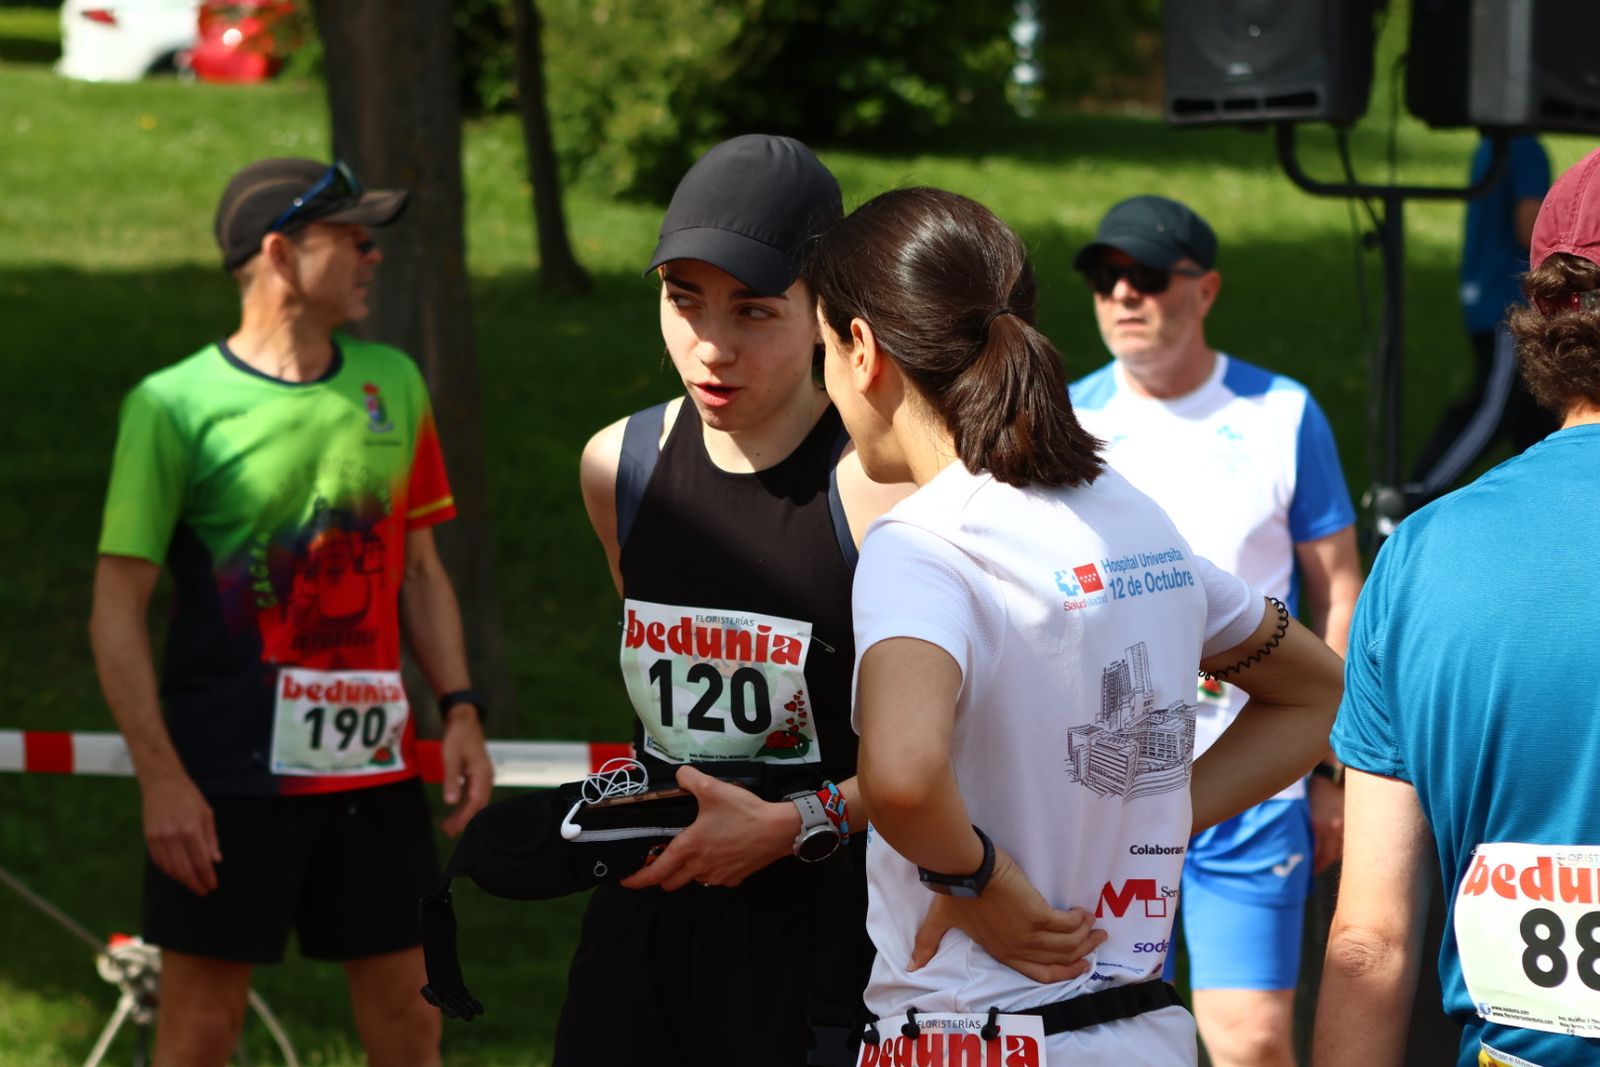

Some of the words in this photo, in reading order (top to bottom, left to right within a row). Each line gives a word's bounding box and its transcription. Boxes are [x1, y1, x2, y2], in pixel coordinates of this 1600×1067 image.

[1100, 555, 1138, 574] Hospital
[1109, 577, 1126, 600] 12
[1128, 576, 1143, 597] de
[1145, 567, 1194, 593] Octubre
[625, 609, 803, 665] bedunia
[695, 614, 755, 627] FLORISTERÍAS
[283, 676, 400, 703] bedunia
[649, 658, 772, 734] 120
[304, 706, 386, 750] 190
[1463, 855, 1600, 904] bedu
